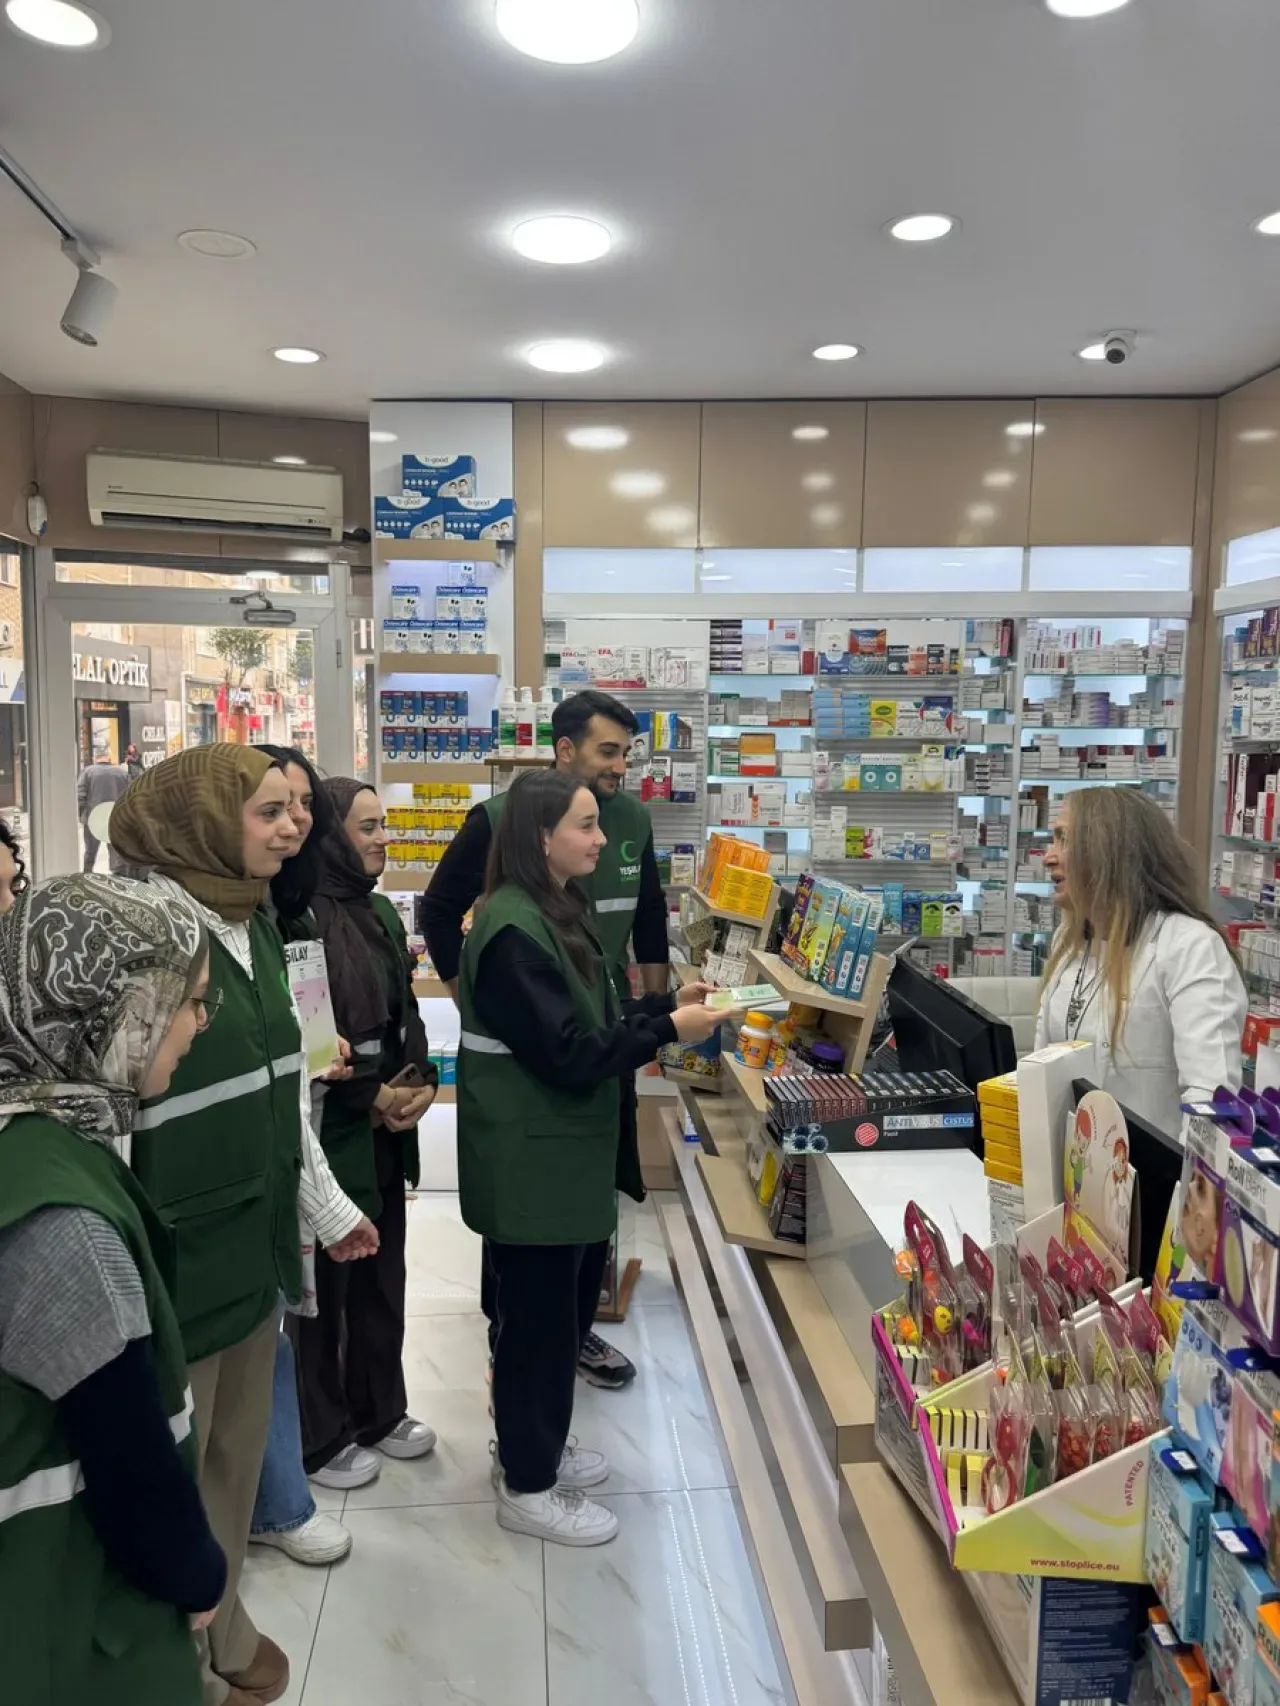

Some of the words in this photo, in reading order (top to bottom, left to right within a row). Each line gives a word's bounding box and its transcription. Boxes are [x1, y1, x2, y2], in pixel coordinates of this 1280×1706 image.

[108, 654, 149, 687] OPTİK
[1124, 1459, 1145, 1508] PATENTED
[1030, 1558, 1120, 1571] www.stoplice.eu
